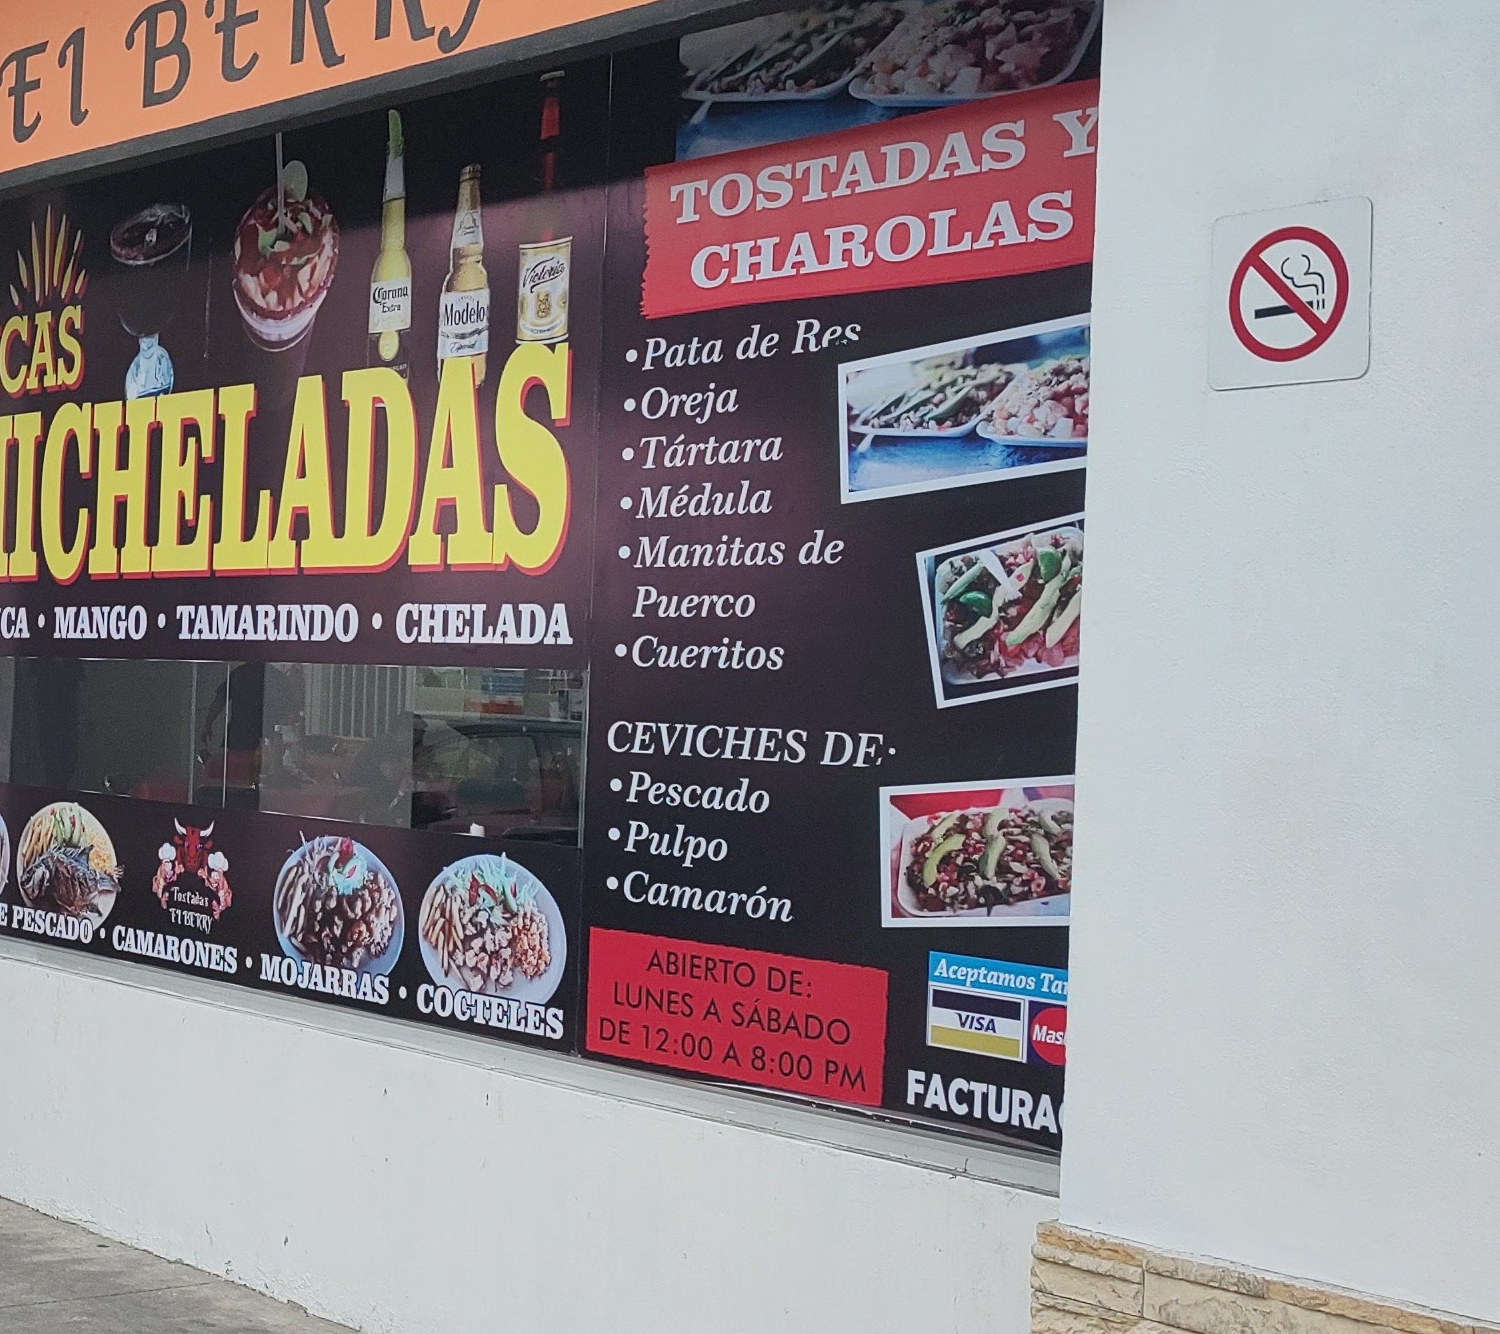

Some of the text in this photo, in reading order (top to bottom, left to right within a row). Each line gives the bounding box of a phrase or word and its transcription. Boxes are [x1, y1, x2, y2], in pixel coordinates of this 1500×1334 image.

[670, 108, 1098, 225] TOSTADAS Y
[691, 190, 1074, 289] CHAROLAS
[373, 285, 409, 304] Corona
[380, 301, 402, 314] Extra
[444, 300, 486, 327] Modelo
[641, 318, 862, 371] Pata de Res
[639, 384, 739, 427] Oreja
[638, 432, 784, 470] Tártara
[635, 481, 773, 520] Médula
[632, 529, 845, 569] Manitas de
[53, 604, 148, 641] MANGO
[176, 603, 360, 643] TAMARINDO
[394, 602, 573, 645] CHELADA
[631, 585, 756, 619] Puerco
[630, 636, 785, 672] Cueritos
[606, 720, 808, 765] CEVICHES
[626, 771, 770, 815] Pescado
[623, 819, 729, 865] Pulpo
[623, 871, 794, 923] Camarón
[12, 903, 94, 945] PESCADO
[111, 924, 238, 974] CAMARONES
[260, 953, 390, 1005] MOJARRAS
[416, 983, 565, 1041] COCTELES
[645, 948, 814, 998] ABIERTO DE:
[934, 957, 1036, 990] Aceptamos
[612, 981, 851, 1046] LUNES A SÁBADO
[956, 1012, 997, 1034] VISA
[1032, 1023, 1066, 1047] Mas
[599, 1016, 868, 1093] DE 12:00 A 8:00 PM
[906, 1068, 1065, 1135] FACTURA
